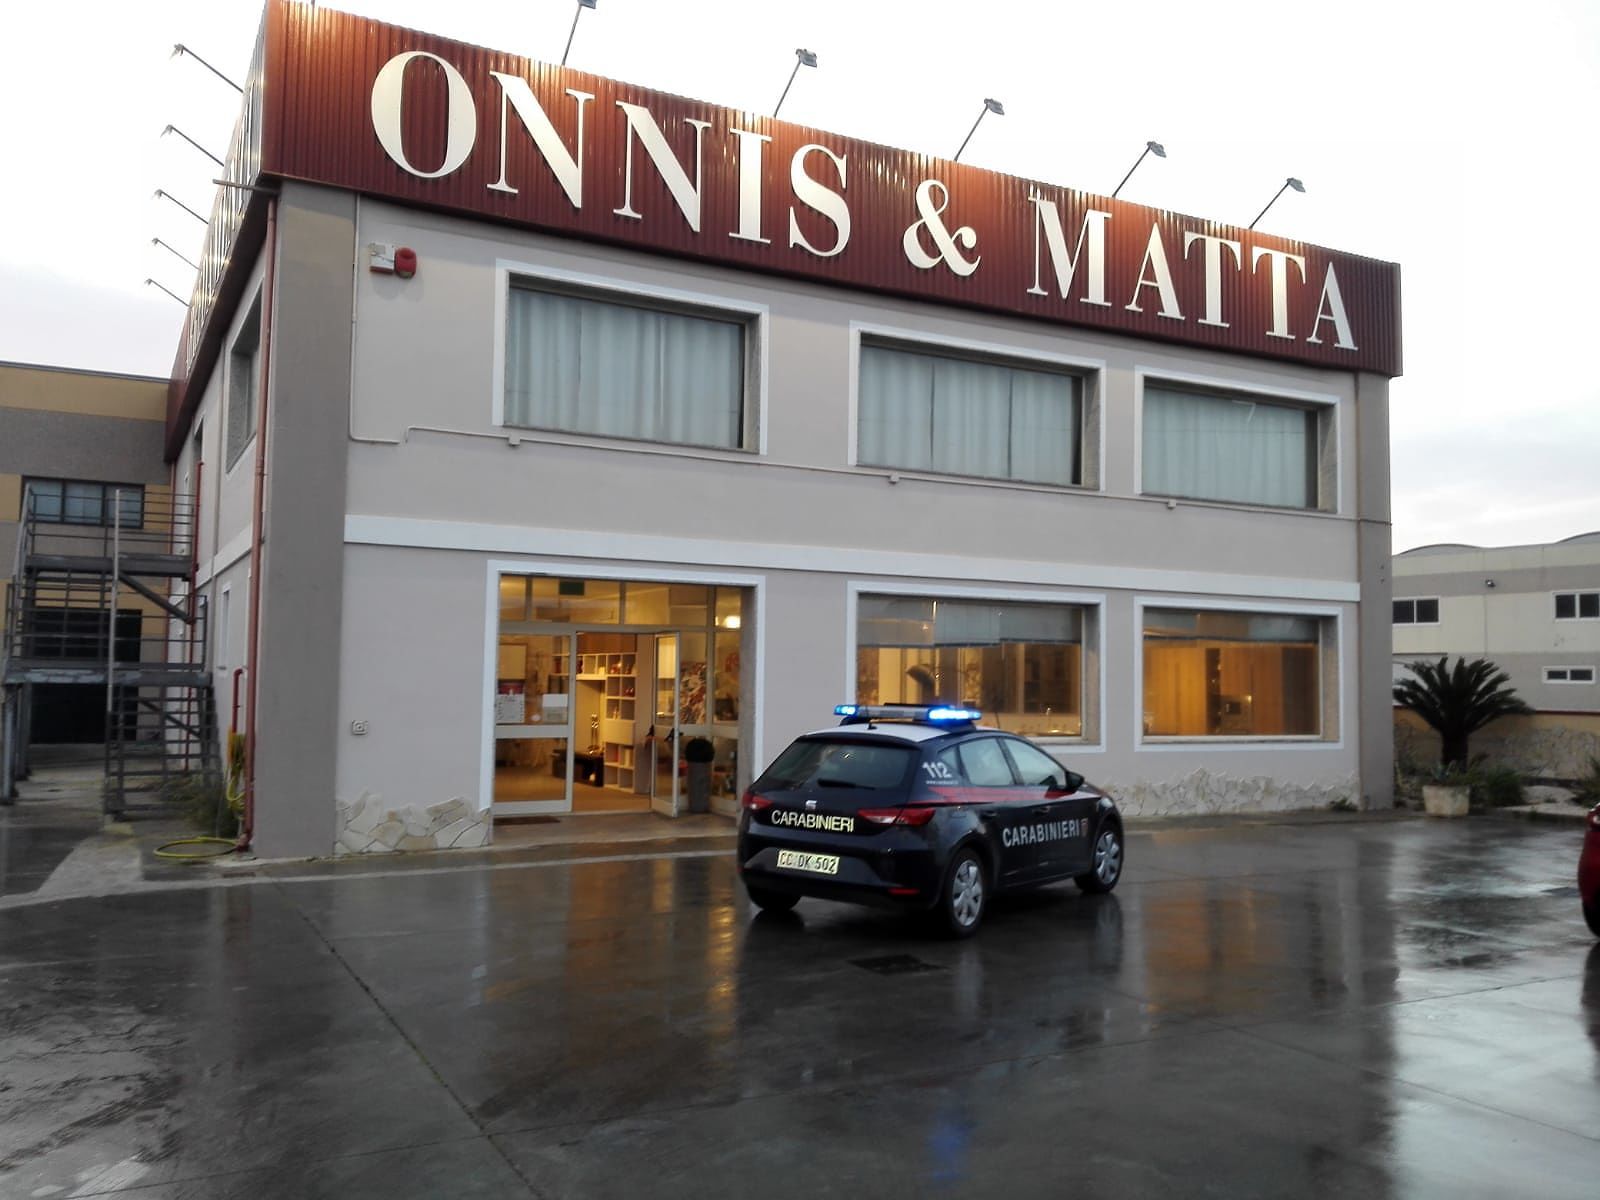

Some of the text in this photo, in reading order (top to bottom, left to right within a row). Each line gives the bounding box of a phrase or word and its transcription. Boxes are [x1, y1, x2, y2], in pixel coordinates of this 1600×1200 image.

[371, 50, 851, 257] ONNIS
[903, 179, 981, 277] &
[1026, 196, 1358, 350] MATTA
[922, 761, 952, 779] 112
[771, 809, 855, 832] CARABINIERI
[1002, 819, 1080, 848] CARABINIERI
[780, 852, 793, 866] CC
[815, 856, 837, 873] 502
